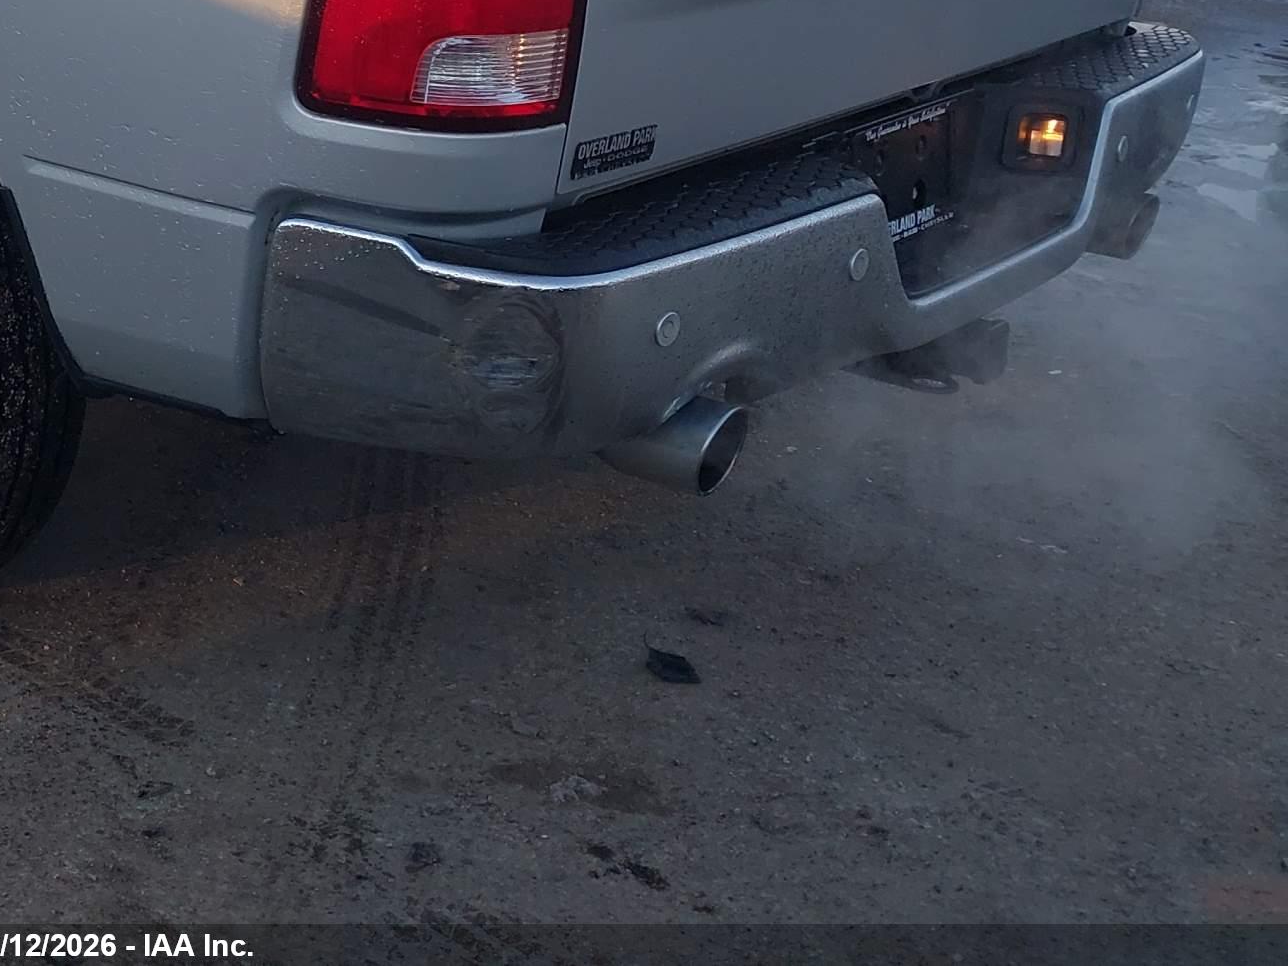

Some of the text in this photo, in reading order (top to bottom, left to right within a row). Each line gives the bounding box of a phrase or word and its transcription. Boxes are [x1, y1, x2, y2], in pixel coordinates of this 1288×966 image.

[577, 134, 632, 160] OVERLAND
[888, 212, 916, 235] ERLAND
[916, 203, 936, 225] PARK
